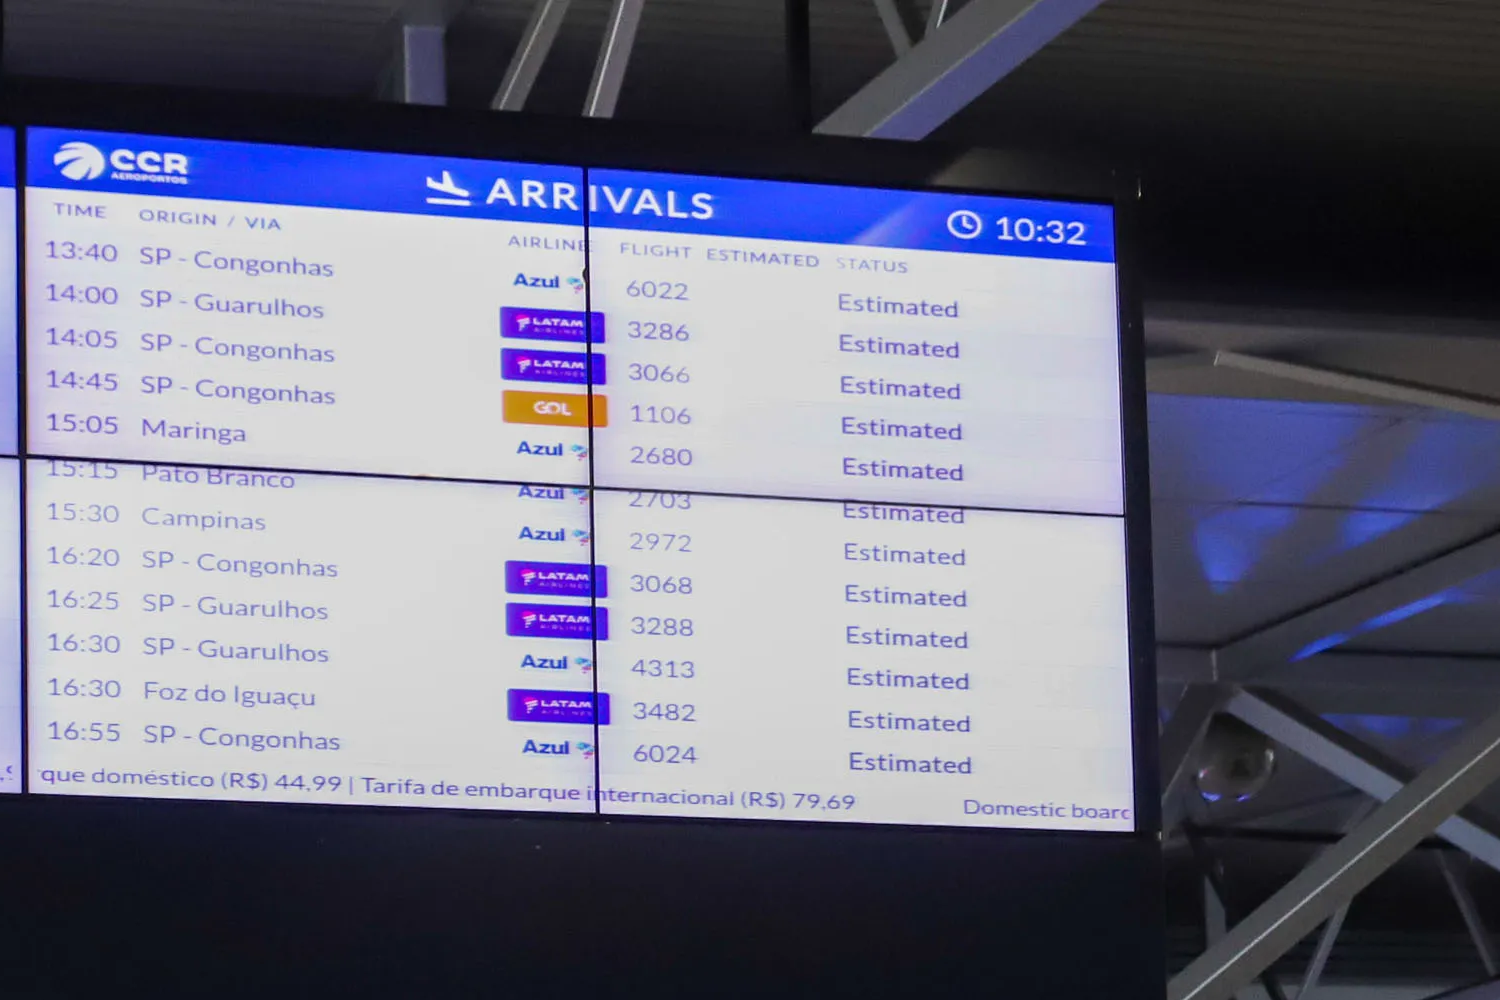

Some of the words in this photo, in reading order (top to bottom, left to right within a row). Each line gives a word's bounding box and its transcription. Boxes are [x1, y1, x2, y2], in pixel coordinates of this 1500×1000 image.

[110, 149, 188, 174] CCR
[486, 178, 714, 219] ARRIVALS
[54, 203, 105, 218] TIME
[139, 210, 216, 226] ORIGIN
[245, 217, 281, 230] VIA
[997, 217, 1086, 245] 10:32
[46, 240, 117, 262] 13:40
[620, 242, 691, 258] FLIGHT
[707, 249, 819, 267] ESTIMATED
[140, 247, 171, 265] SP
[194, 251, 333, 277] Congonhas
[837, 258, 908, 273] STATUS
[514, 273, 559, 288] Azul
[627, 280, 689, 300] 6022
[46, 284, 118, 304] 14:00
[141, 290, 172, 307] SP
[194, 294, 324, 318] Guarulhos
[839, 294, 958, 318] Estimated
[628, 321, 689, 341] 3286
[840, 334, 959, 358] Estimated
[47, 370, 118, 391] 14:45
[142, 376, 172, 394] SP
[196, 379, 335, 404] Congonhas
[533, 401, 571, 416] GOL
[631, 405, 691, 424] 1106
[47, 413, 118, 434] 15:05
[842, 417, 963, 440] Estimated
[517, 441, 563, 456] Azul
[631, 446, 692, 466] 2680
[142, 464, 199, 484] Pato
[206, 468, 295, 489] Branco
[843, 458, 963, 481] Estimated
[48, 502, 119, 523] 15:30
[142, 508, 266, 531] Campinas
[519, 527, 565, 541] Azul
[630, 532, 692, 552] 2972
[48, 546, 120, 566] 16:20
[143, 551, 174, 568] SP
[197, 554, 337, 577] Congonhas
[845, 543, 965, 565] Estimated
[631, 575, 692, 594] 3068
[846, 585, 967, 607] Estimated
[49, 678, 121, 698] 16:30
[145, 682, 188, 701] Foz
[195, 685, 226, 702] do
[235, 686, 315, 709] Iguaçu
[633, 702, 696, 721] 3482
[849, 711, 970, 732] Estimated
[48, 721, 120, 741] 16:55
[144, 725, 176, 743] SP
[199, 727, 340, 752] Congonhas
[523, 740, 569, 754] Azul
[634, 745, 697, 763] 6024
[850, 752, 972, 774] Estimated
[92, 768, 214, 787] doméstico
[221, 773, 267, 791] (R$)
[361, 778, 425, 794] Tarifa
[431, 781, 459, 795] de
[465, 783, 581, 802] embarque
[586, 784, 735, 805] internacional
[741, 792, 785, 809] (R$)
